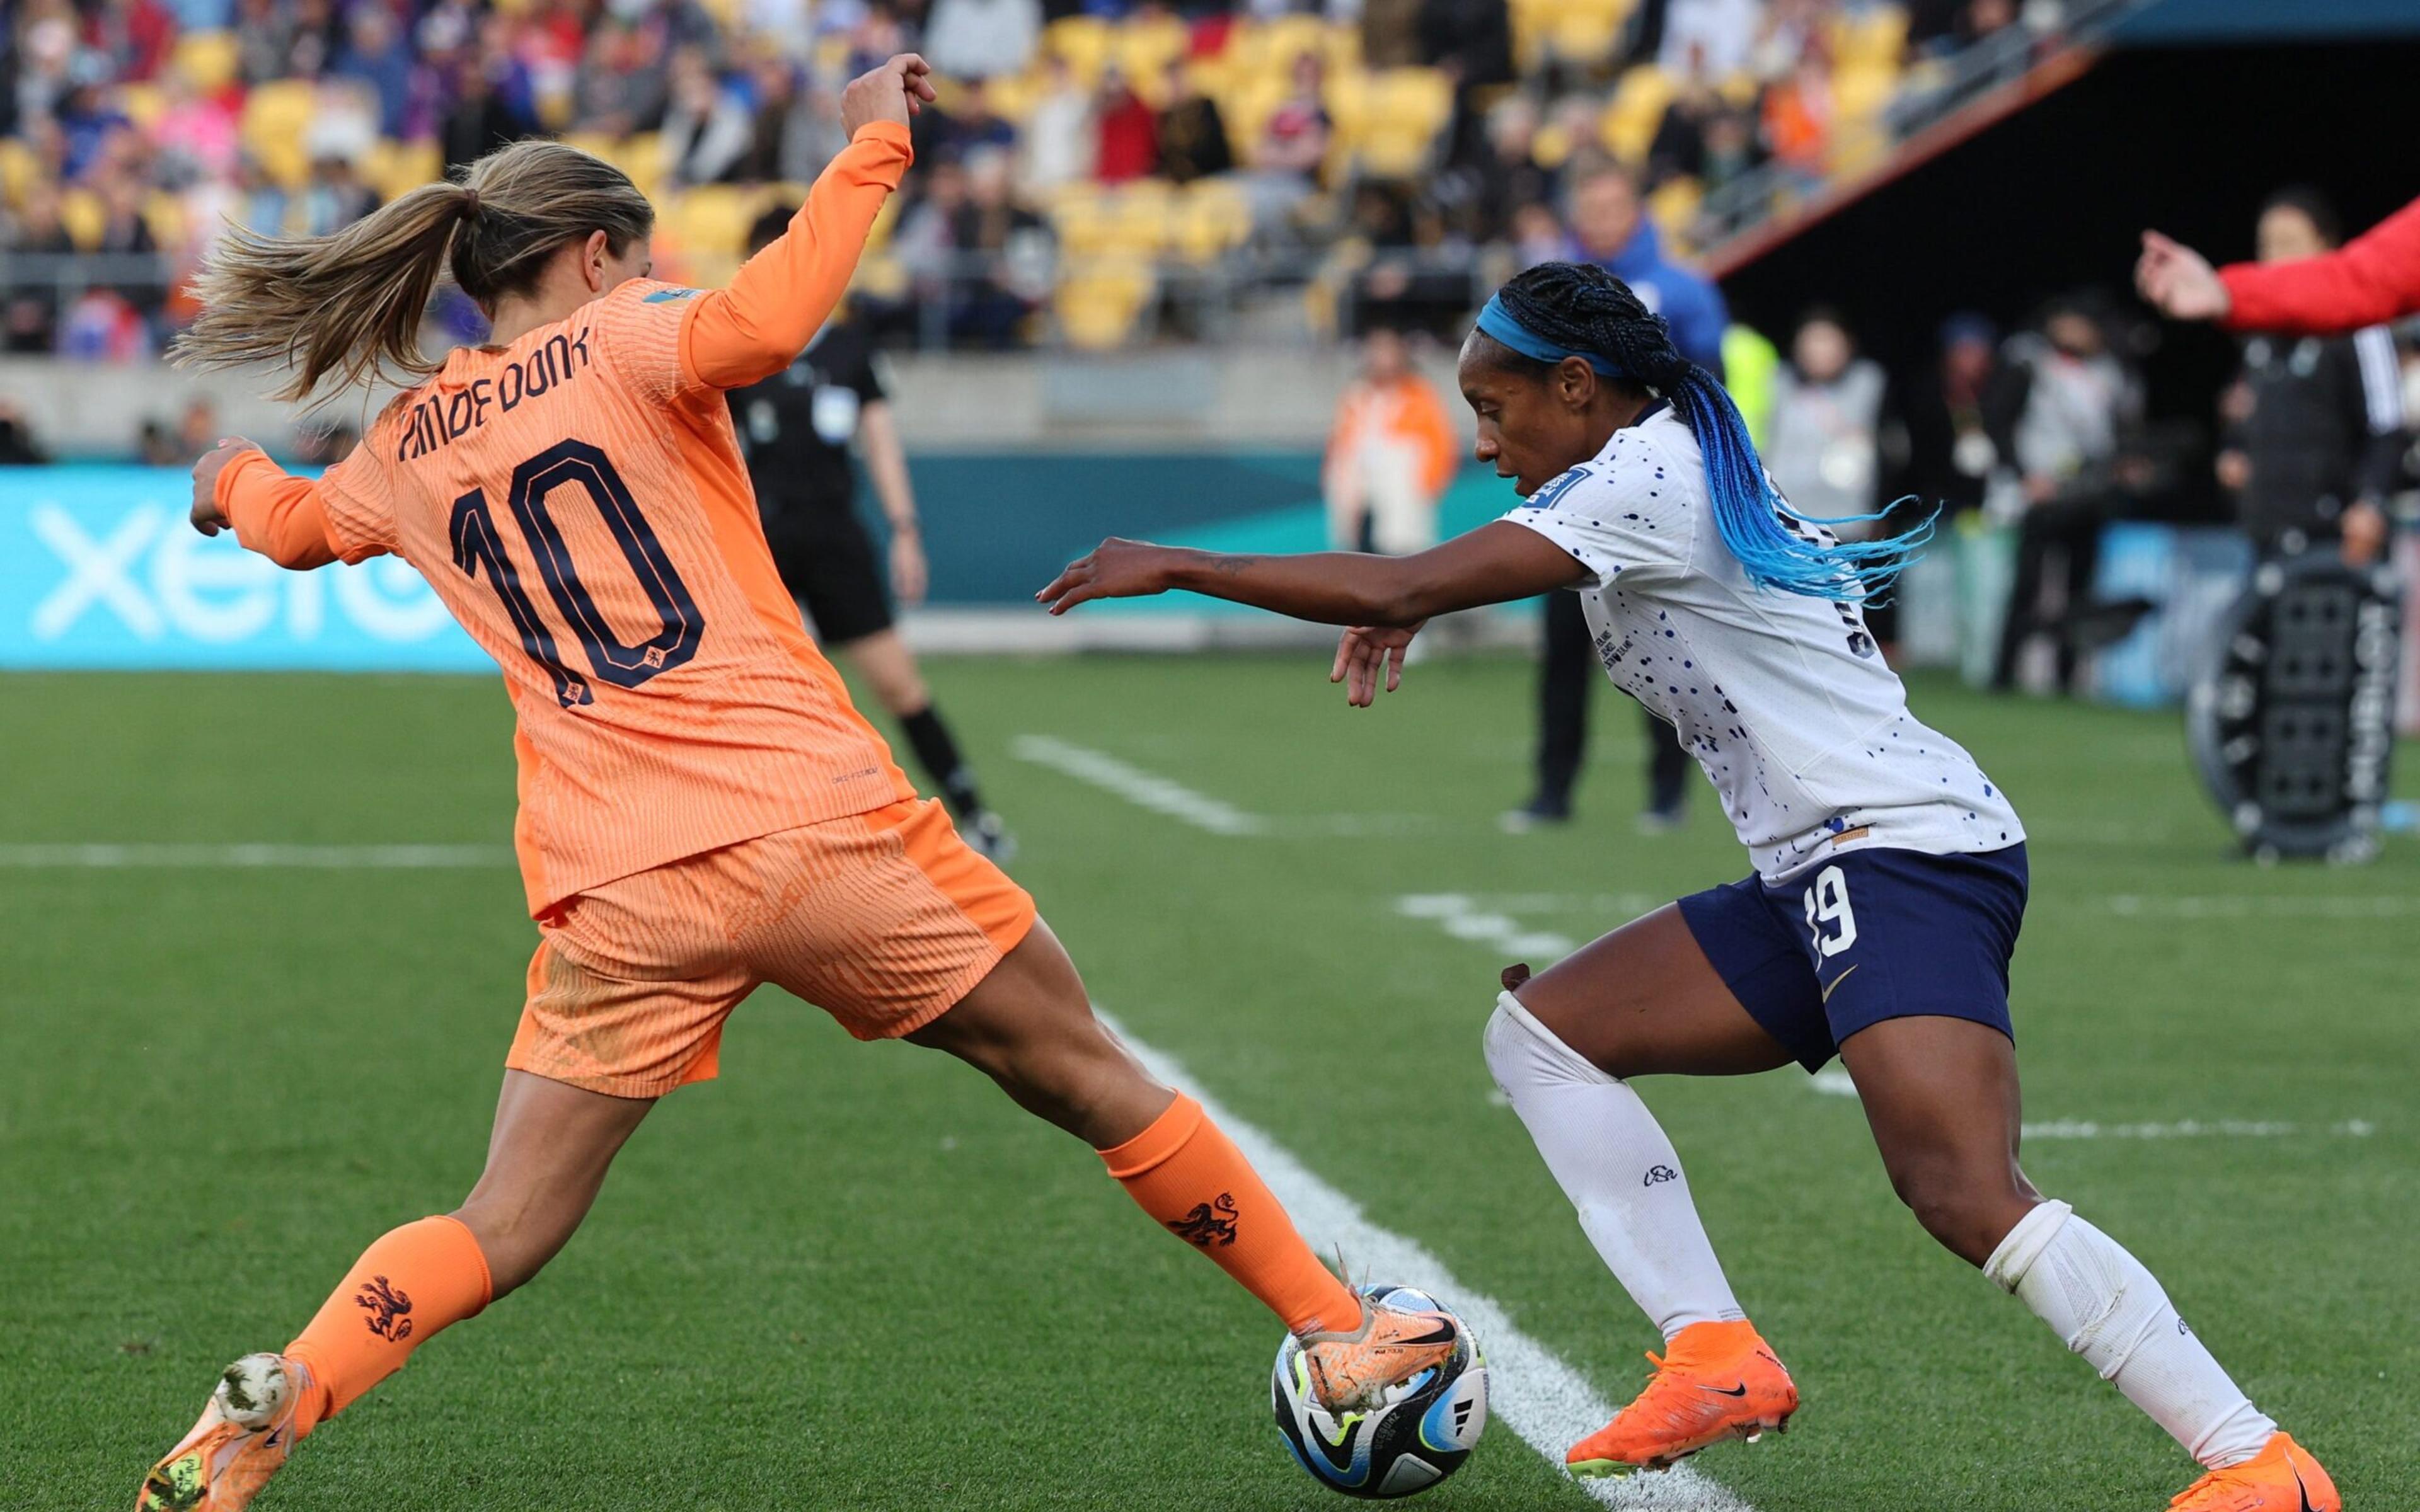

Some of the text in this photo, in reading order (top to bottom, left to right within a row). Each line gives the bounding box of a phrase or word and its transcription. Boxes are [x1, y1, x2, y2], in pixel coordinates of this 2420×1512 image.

[498, 326, 589, 413] DONK
[449, 438, 705, 709] 10
[1804, 865, 1857, 972] 19
